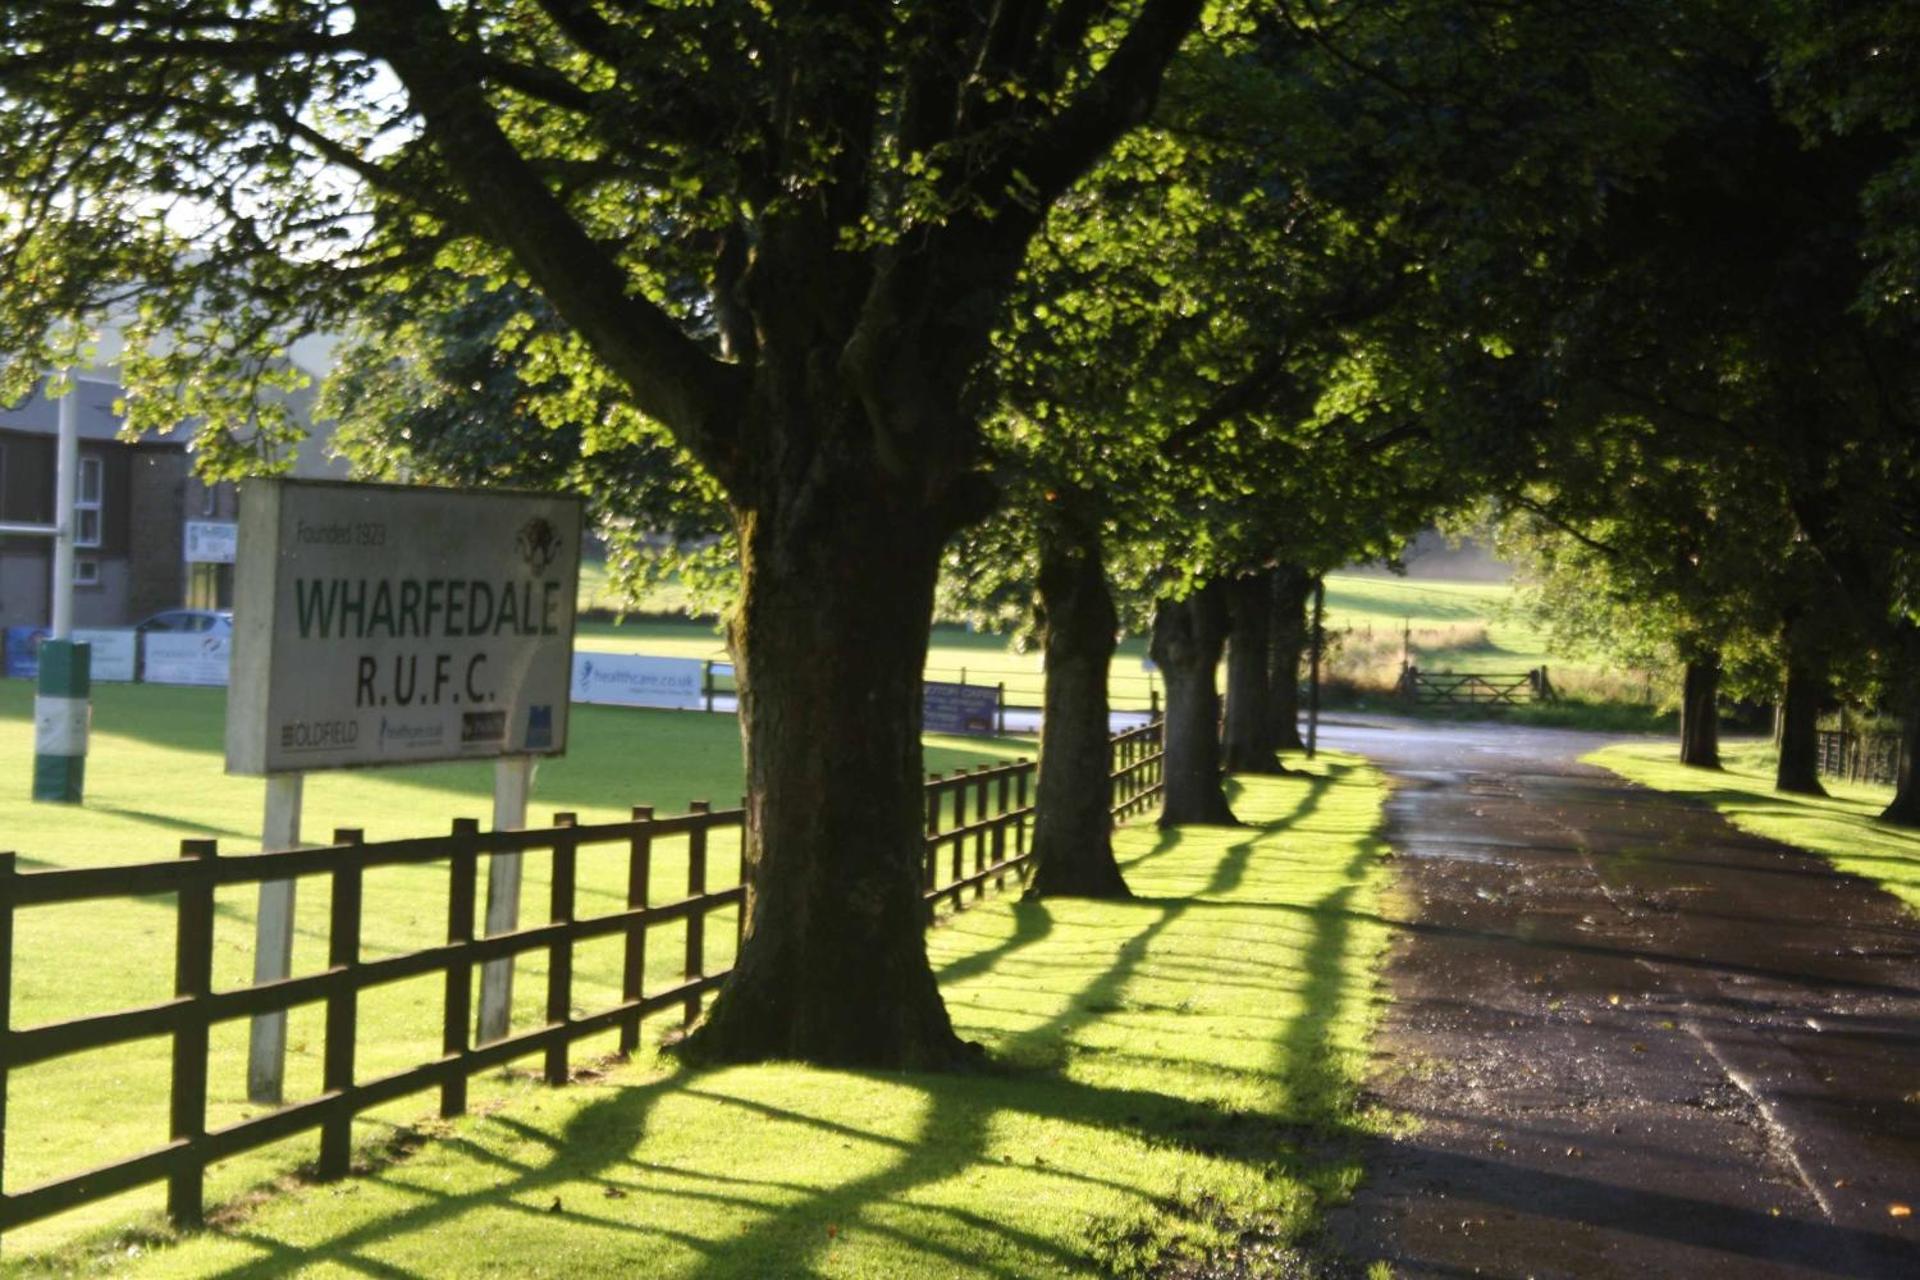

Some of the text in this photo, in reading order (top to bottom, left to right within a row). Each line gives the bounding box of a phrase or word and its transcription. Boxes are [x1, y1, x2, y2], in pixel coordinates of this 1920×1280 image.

[298, 521, 351, 544] Founded
[296, 577, 560, 638] WHARFEDALE
[356, 653, 495, 707] R.U.F.C.
[296, 720, 359, 746] OLDFIELD
